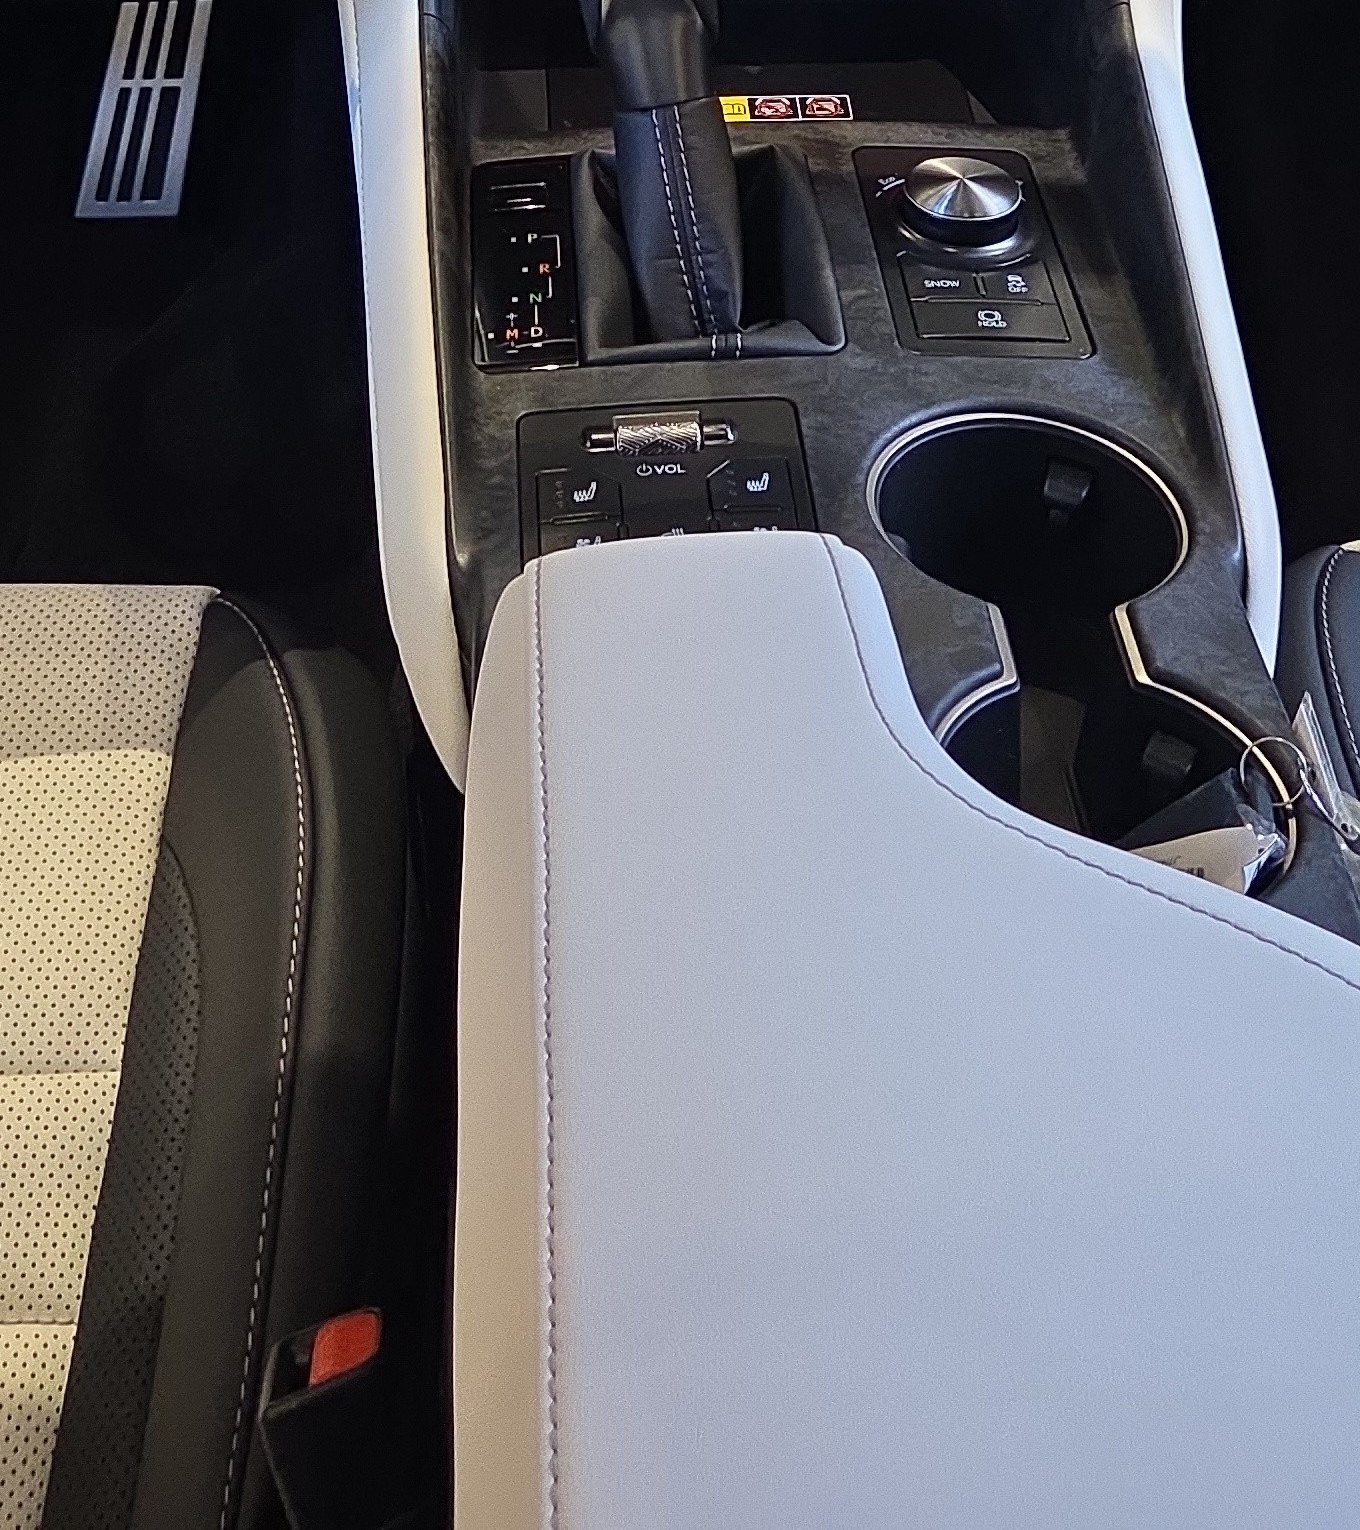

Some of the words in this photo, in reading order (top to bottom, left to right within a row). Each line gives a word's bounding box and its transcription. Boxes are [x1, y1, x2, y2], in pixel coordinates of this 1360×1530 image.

[527, 233, 537, 244] P
[539, 263, 550, 274] R
[924, 279, 960, 288] SNOW
[529, 292, 543, 304] N
[506, 328, 519, 340] M
[530, 326, 543, 338] D
[653, 464, 687, 475] VOL
